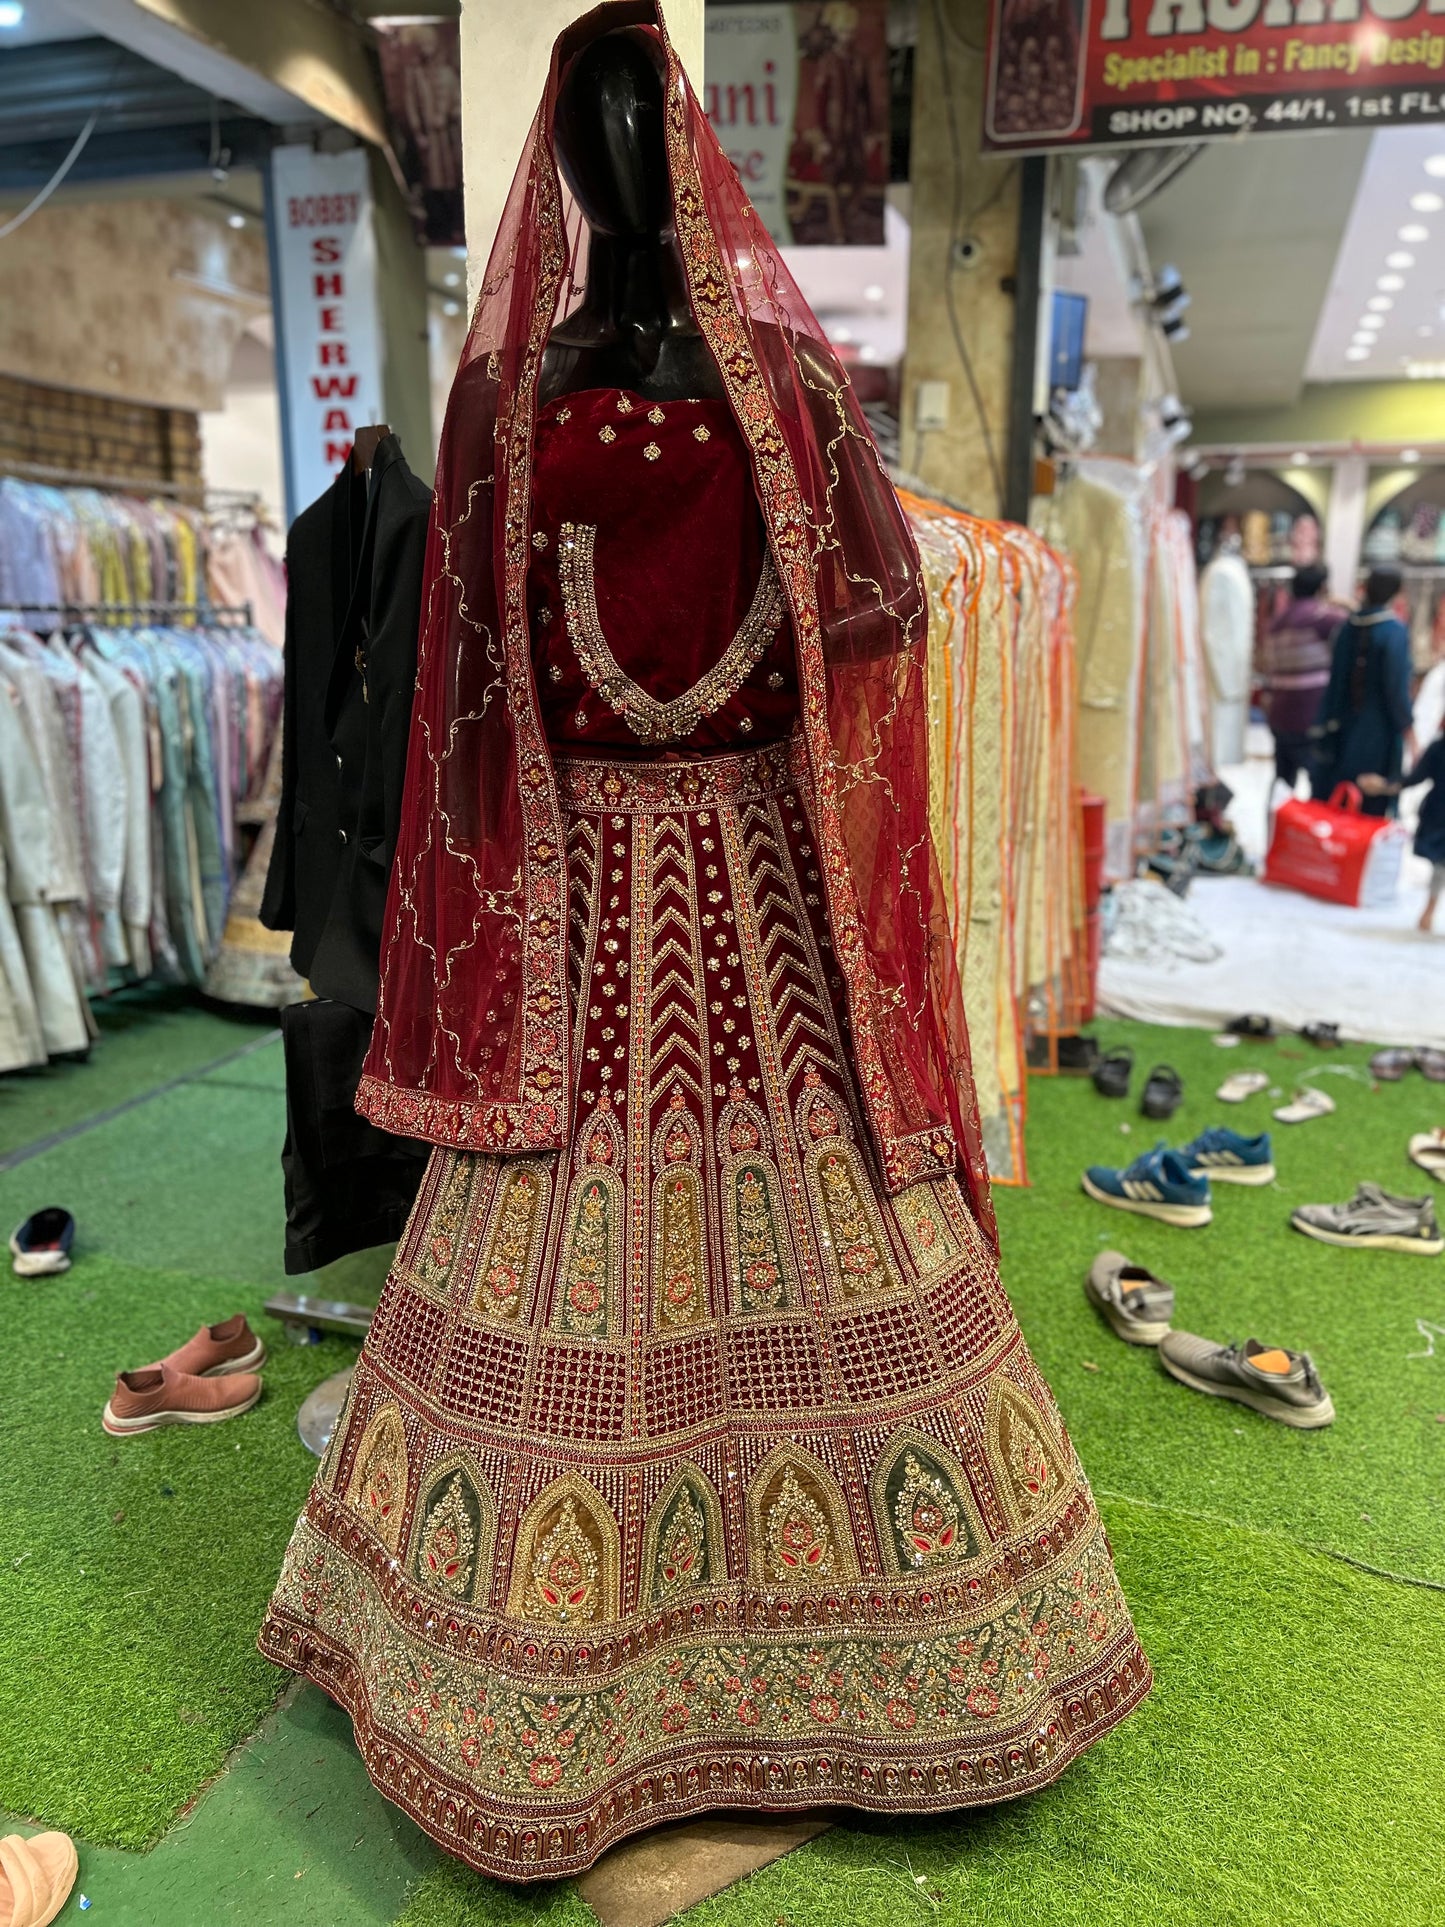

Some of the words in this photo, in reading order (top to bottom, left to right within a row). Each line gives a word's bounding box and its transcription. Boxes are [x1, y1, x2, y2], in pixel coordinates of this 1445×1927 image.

[1103, 47, 1228, 90] Specialist
[1234, 43, 1260, 75] in
[1284, 39, 1361, 75] Fancy
[1109, 104, 1198, 134] SHOP
[1345, 95, 1392, 117] 1st
